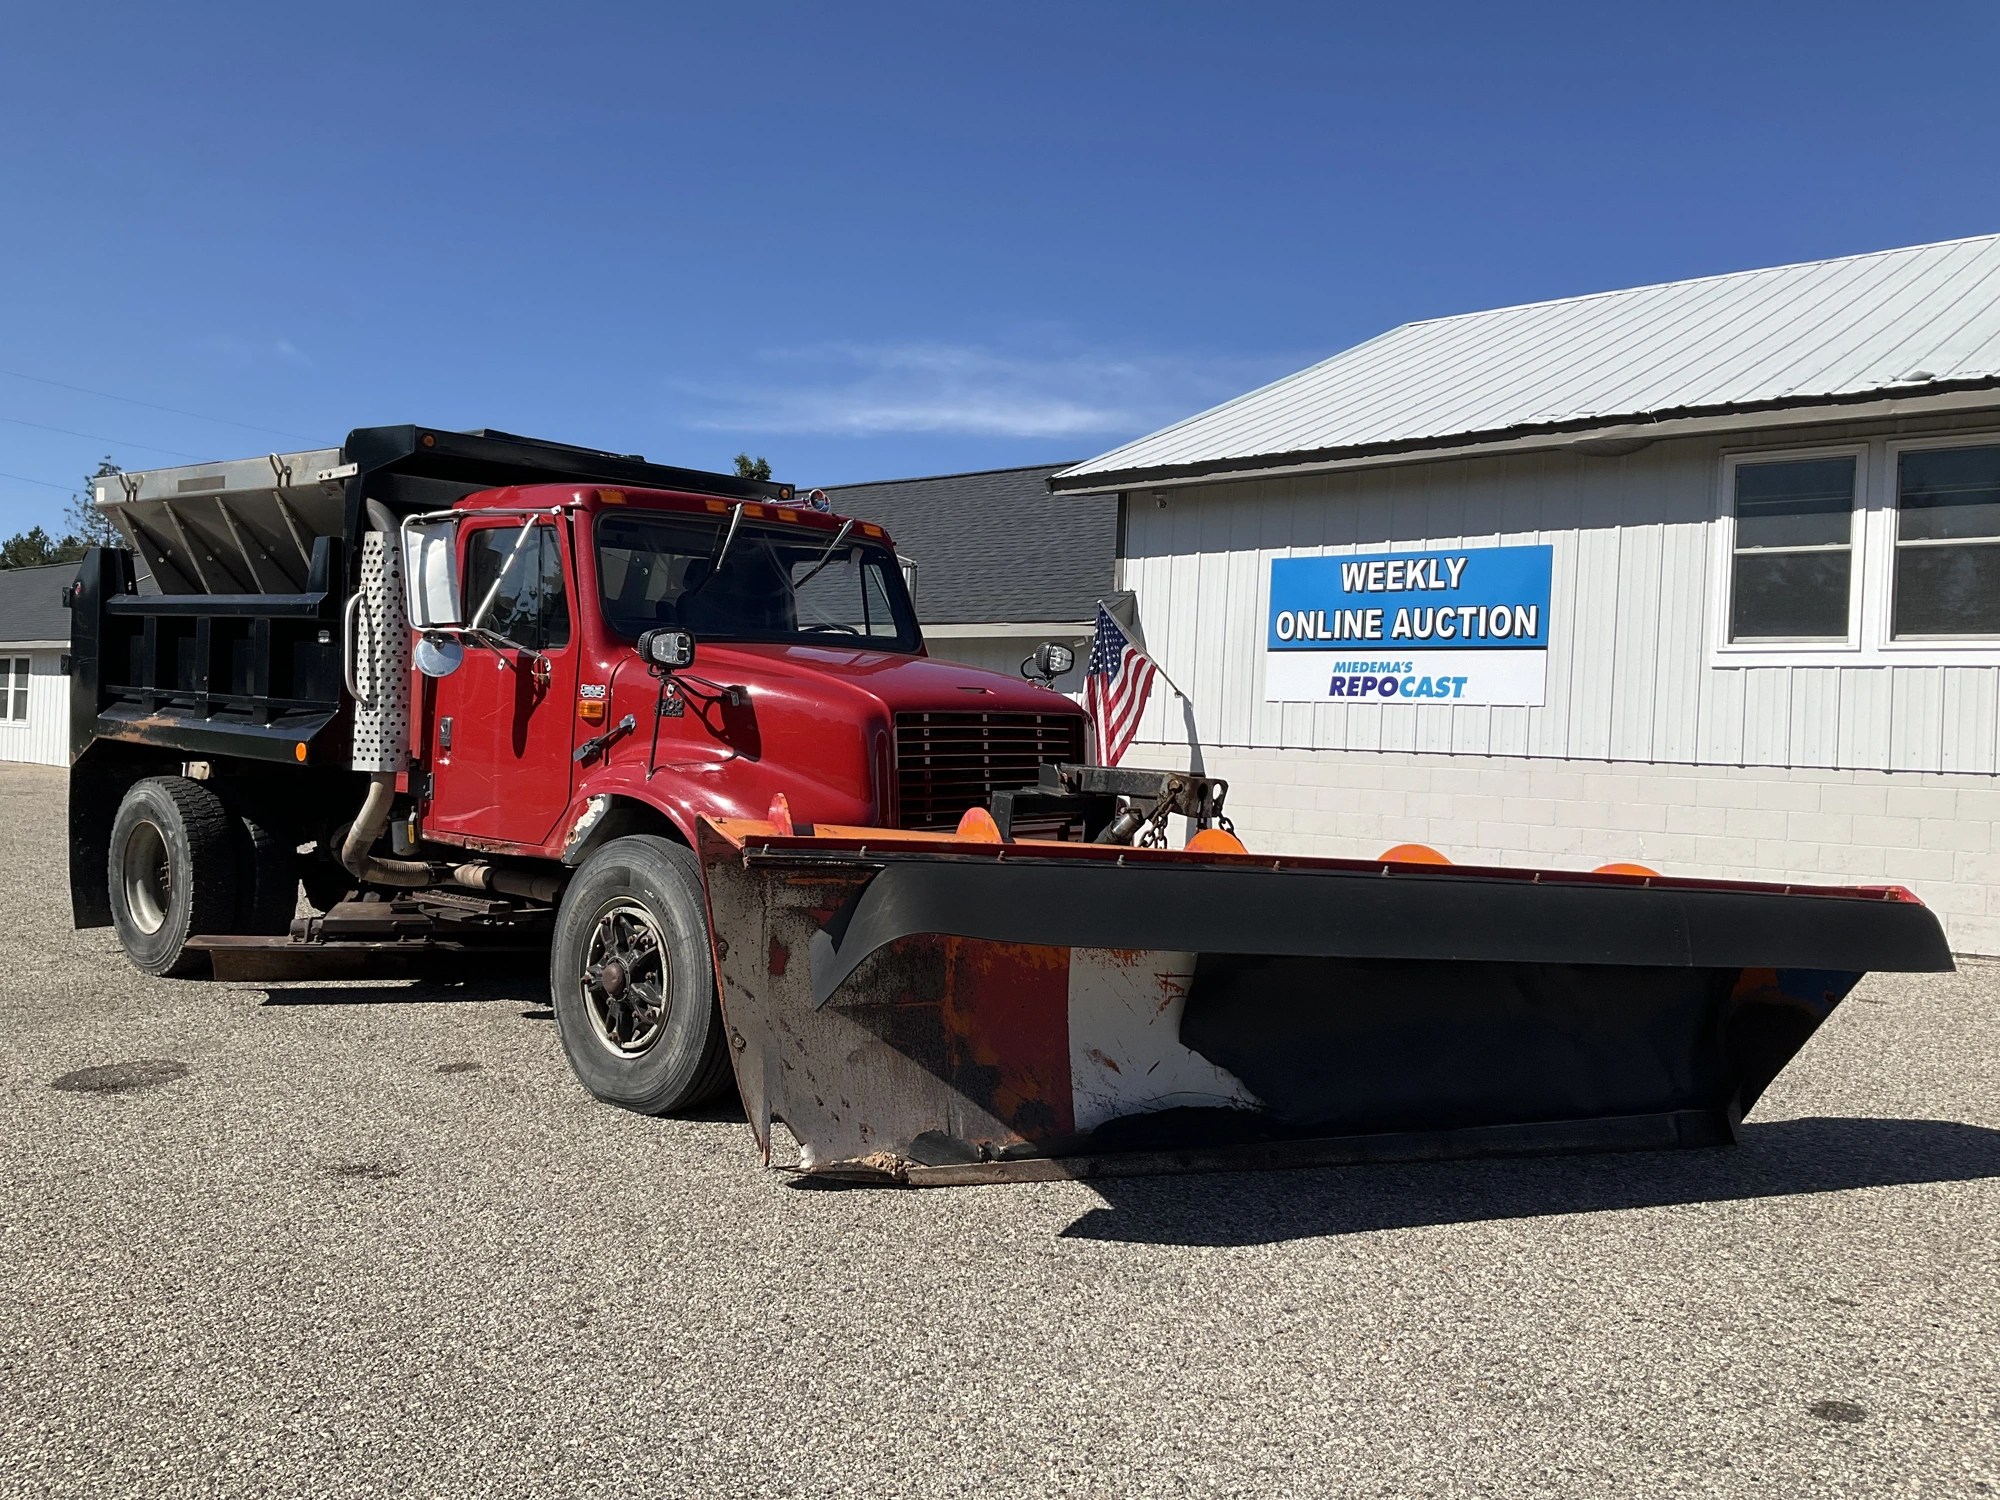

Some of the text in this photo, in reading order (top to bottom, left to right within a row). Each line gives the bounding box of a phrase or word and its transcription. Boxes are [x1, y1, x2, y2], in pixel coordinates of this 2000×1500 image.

[1341, 557, 1467, 592] WEEKLY
[1276, 604, 1538, 641] ONLINE AUCTION
[1333, 661, 1413, 673] MIEDEMA'S
[1329, 676, 1468, 698] REPOCAST
